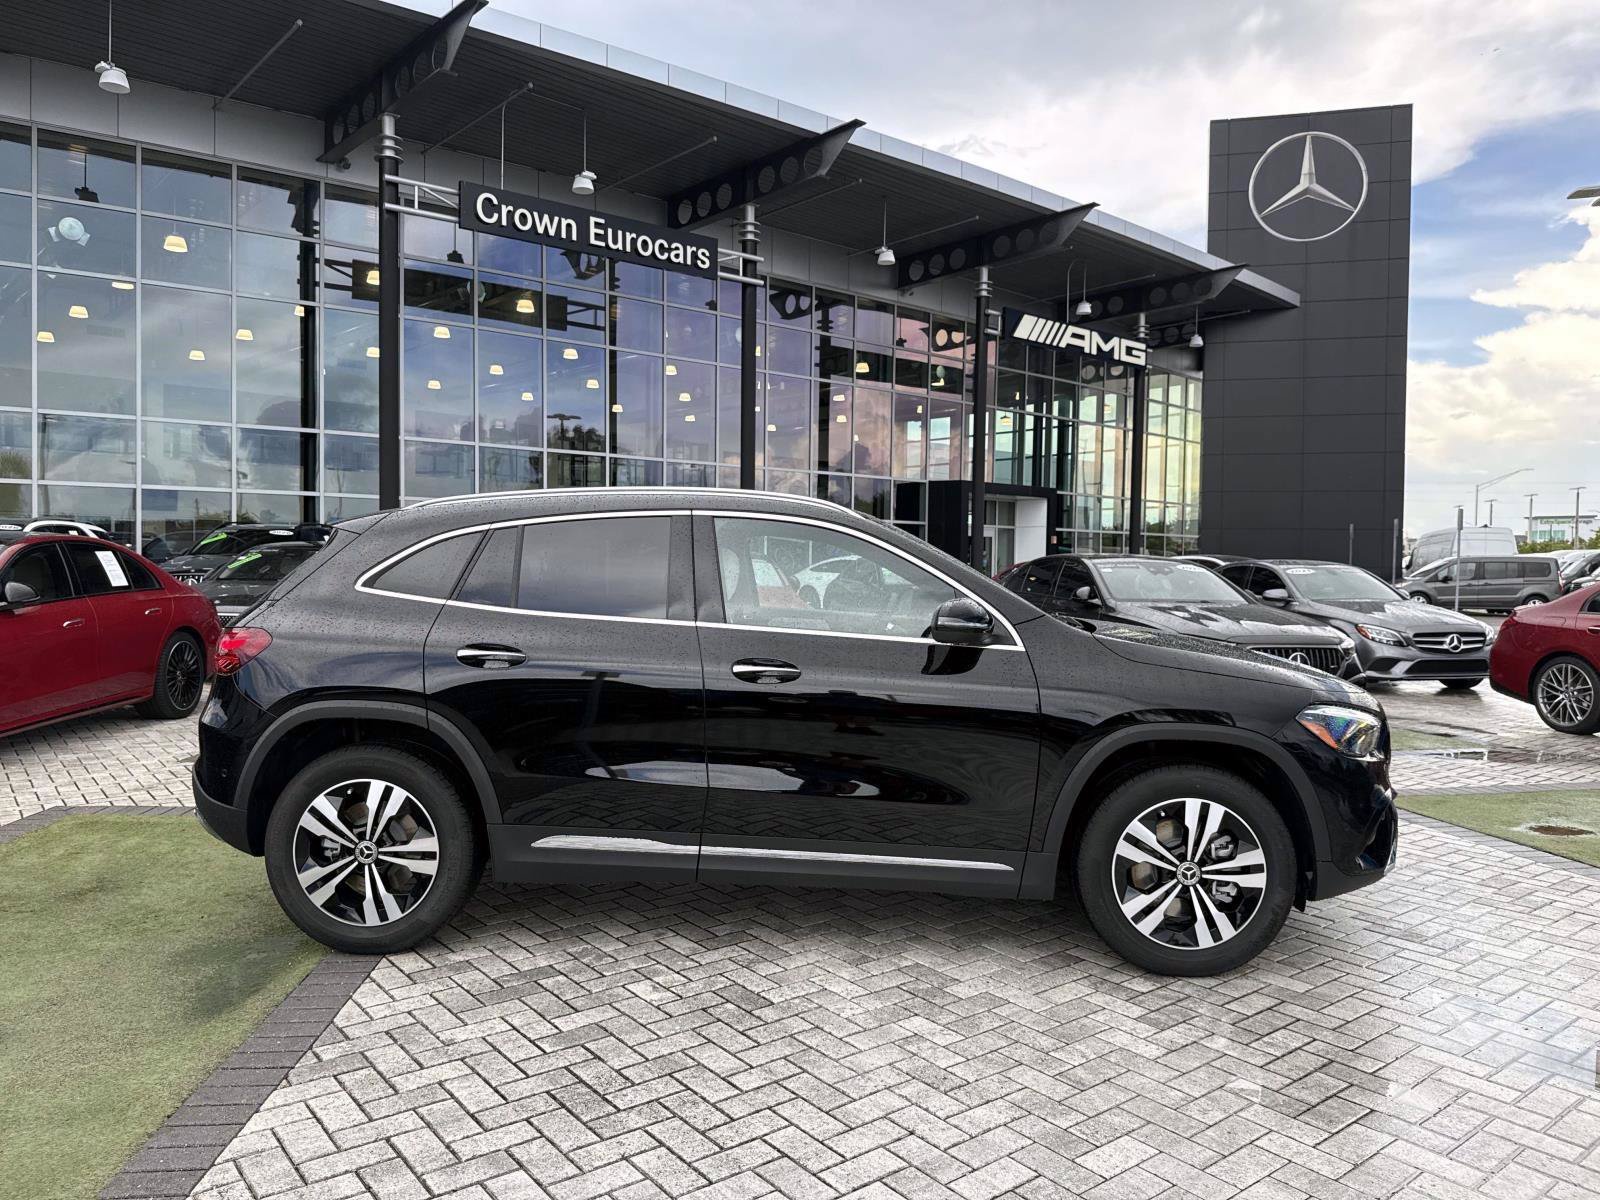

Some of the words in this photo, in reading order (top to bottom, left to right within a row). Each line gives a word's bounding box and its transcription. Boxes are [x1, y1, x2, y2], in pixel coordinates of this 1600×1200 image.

[475, 192, 578, 242] Crown
[589, 215, 711, 269] Eurocars
[1058, 324, 1147, 366] AMG
